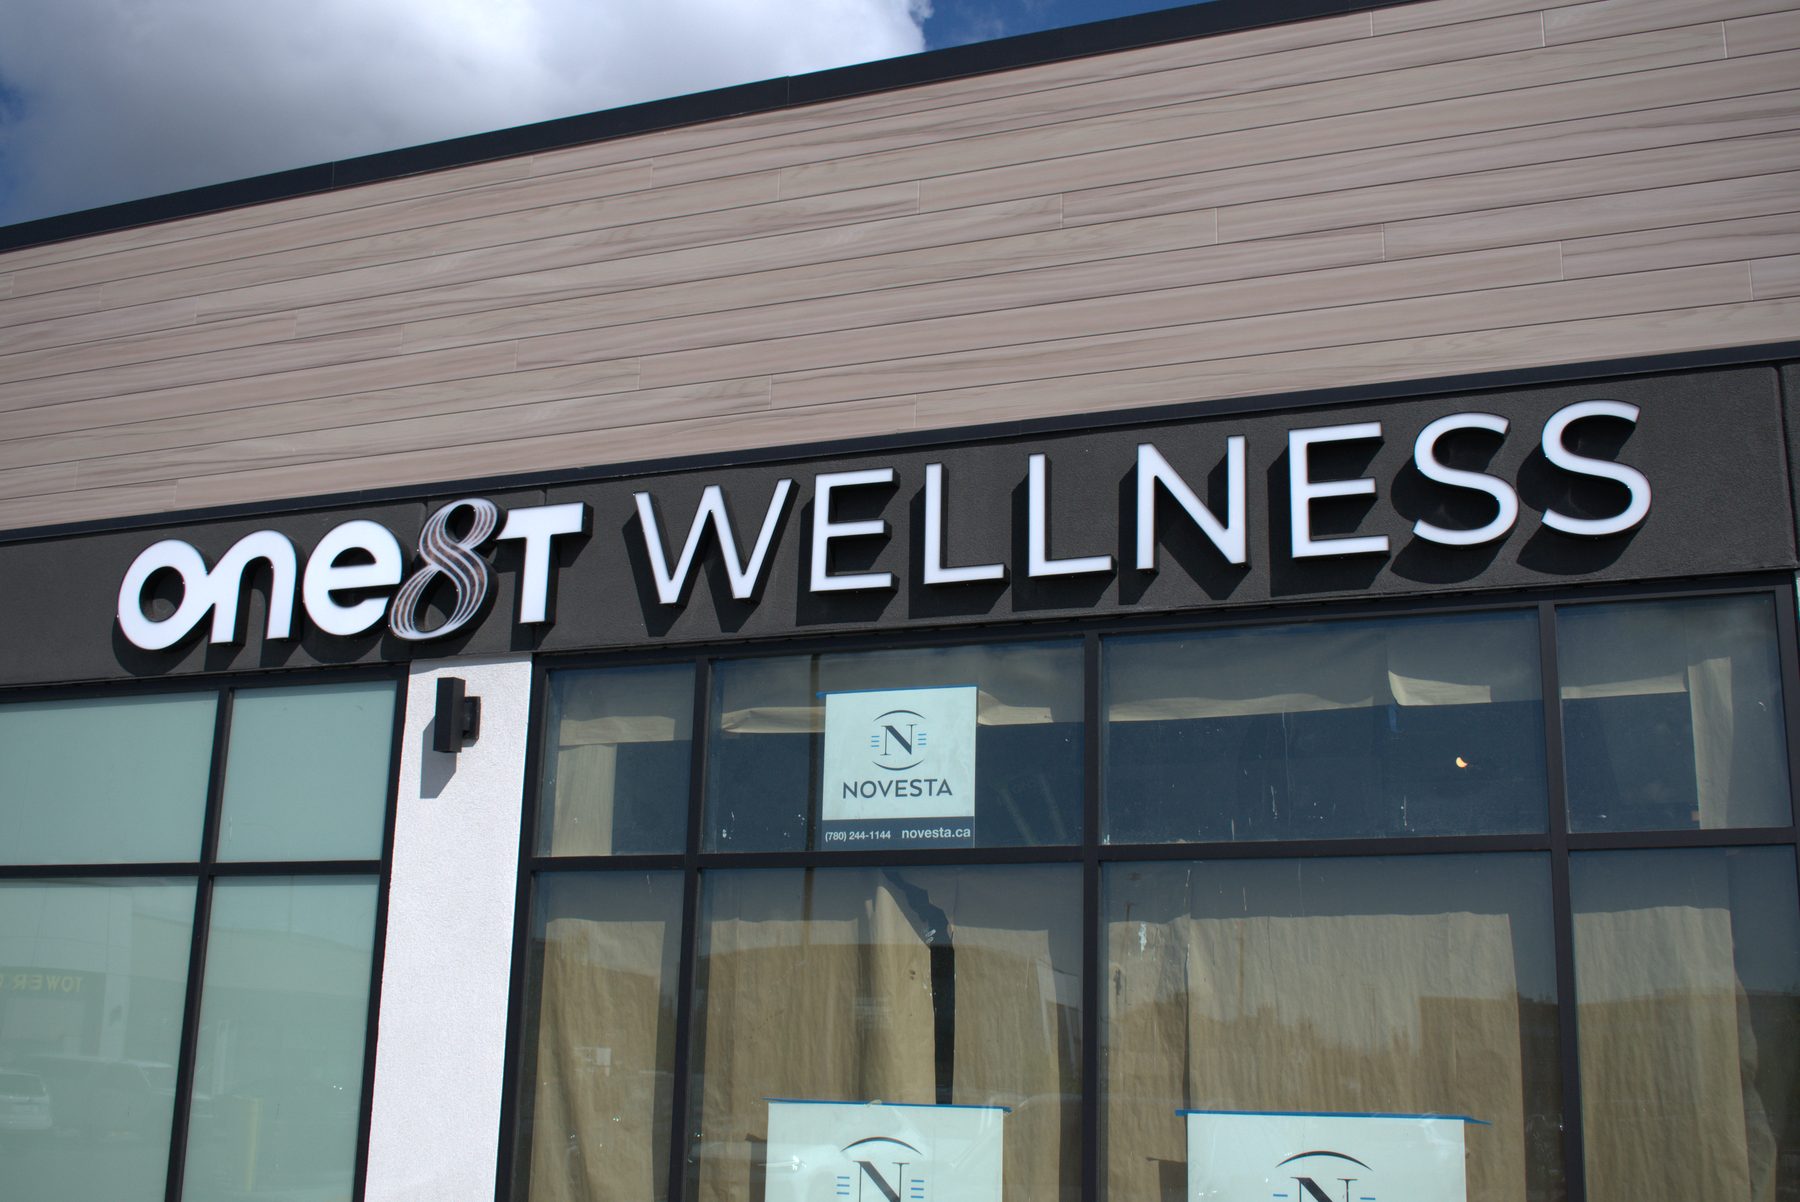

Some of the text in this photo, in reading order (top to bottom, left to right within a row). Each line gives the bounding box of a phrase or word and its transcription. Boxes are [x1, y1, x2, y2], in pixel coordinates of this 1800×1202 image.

[633, 399, 1653, 606] WELLNESS
[880, 723, 918, 757] N
[842, 778, 953, 800] NOVESTA
[825, 826, 971, 843] (780) 244-1144 novesta.ca
